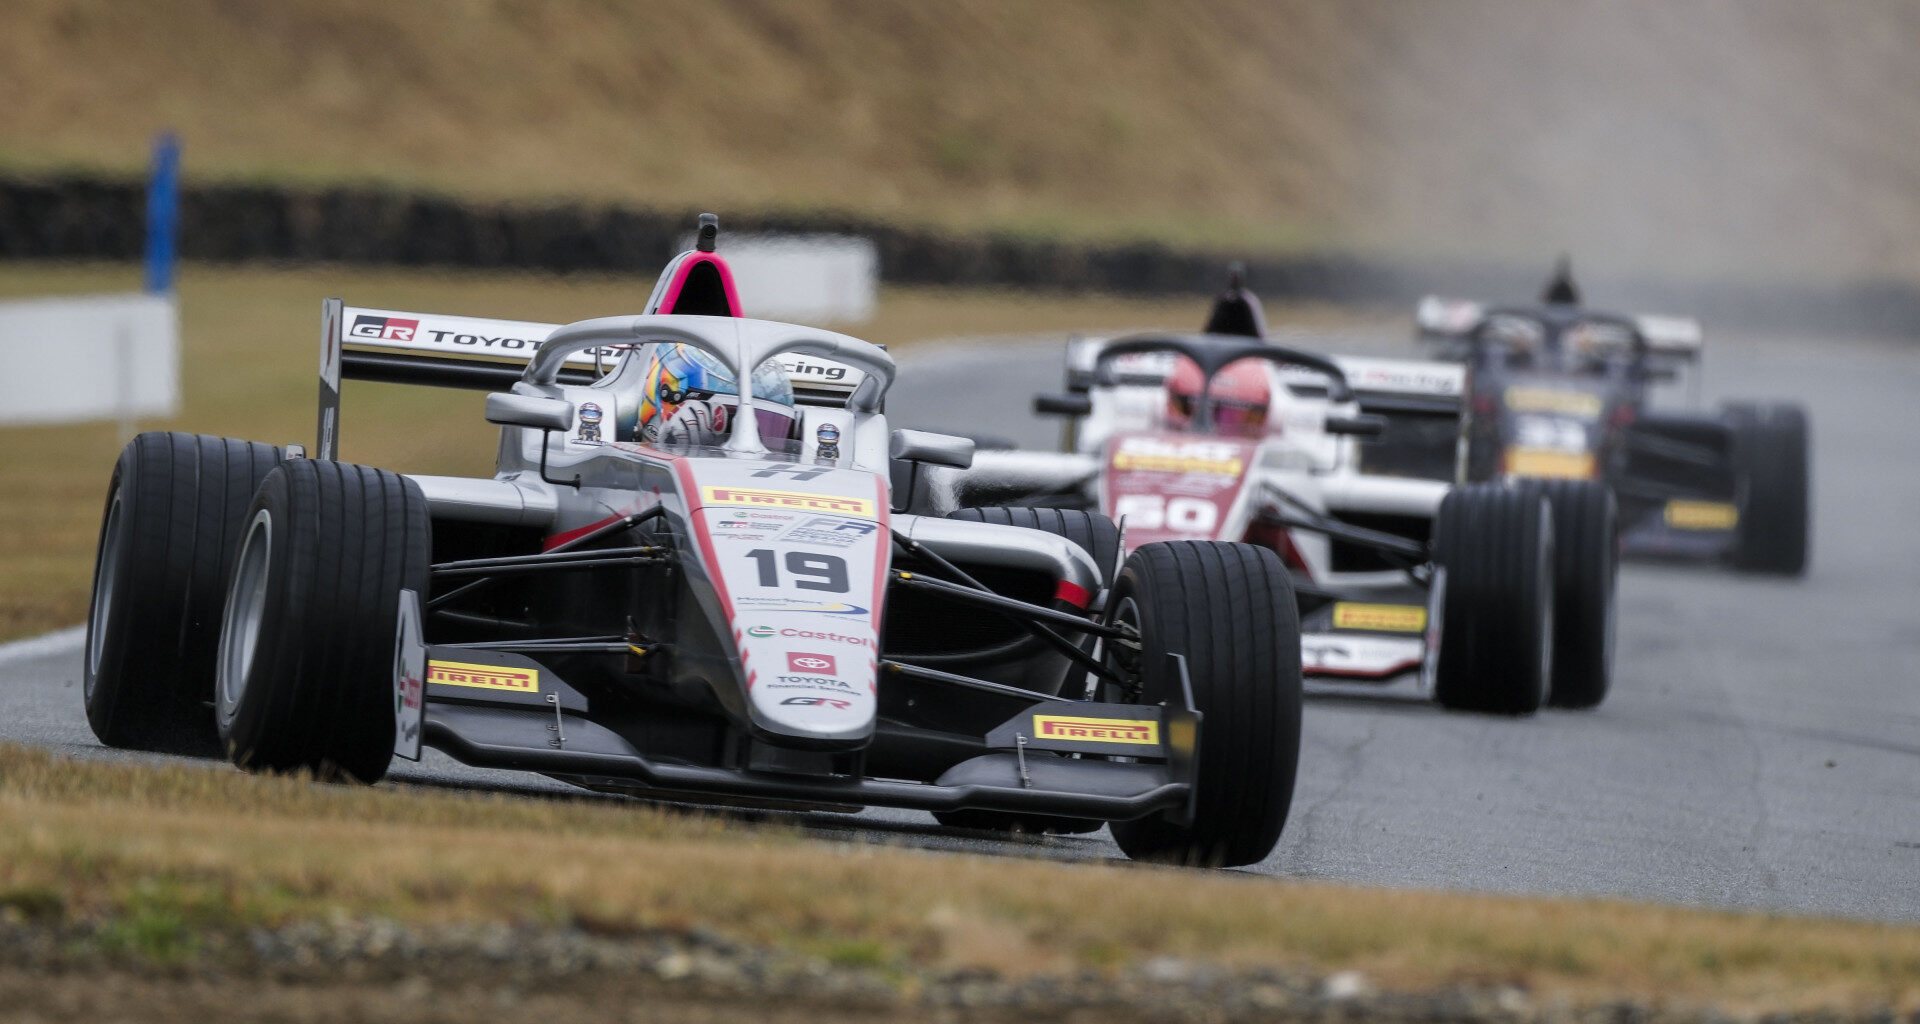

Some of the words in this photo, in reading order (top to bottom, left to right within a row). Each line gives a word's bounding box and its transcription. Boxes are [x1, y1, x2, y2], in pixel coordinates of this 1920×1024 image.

[352, 321, 416, 342] GR
[429, 331, 544, 351] TOYOT
[784, 361, 847, 380] cing
[712, 489, 864, 512] PIRELLI
[744, 549, 850, 593] 19
[780, 628, 868, 646] Castrol
[427, 665, 530, 688] PIRELLI
[778, 676, 852, 688] TOYOTA
[779, 696, 852, 710] GR
[1042, 721, 1150, 740] PIRELLI
